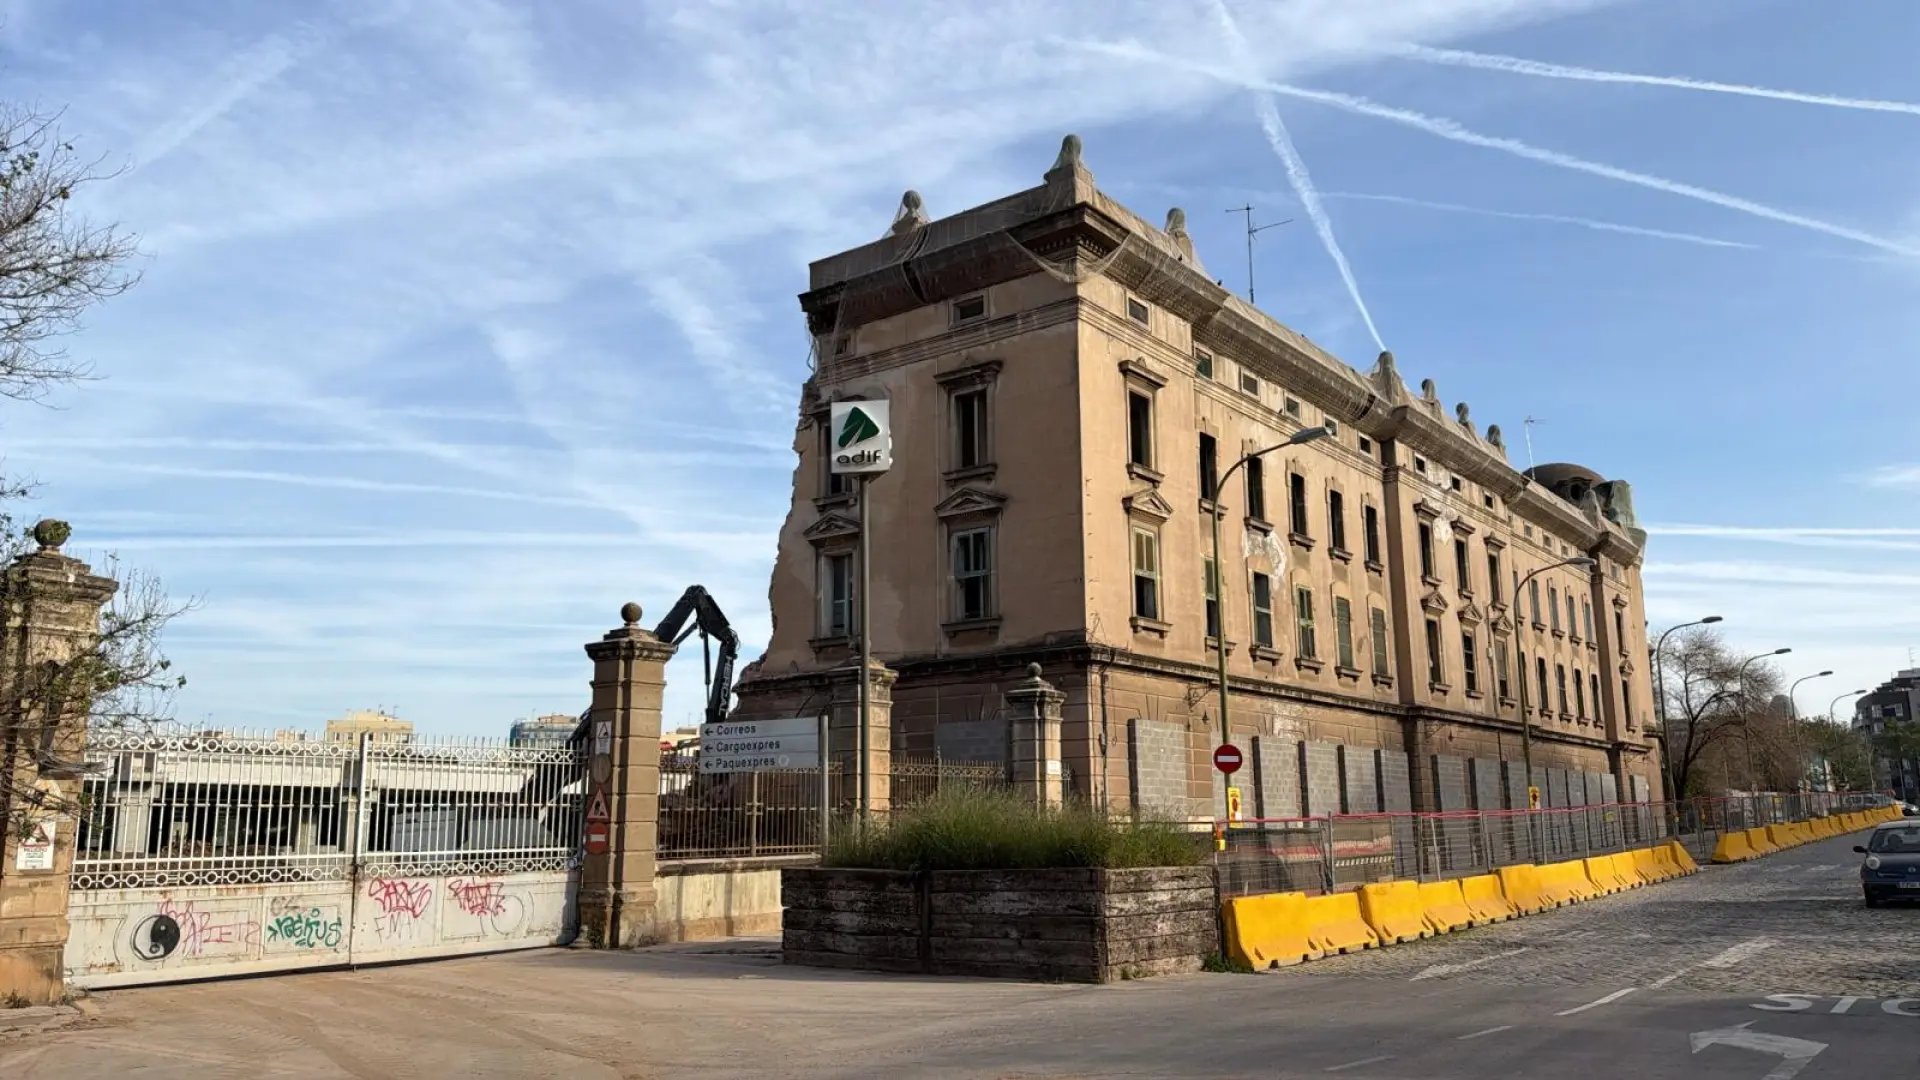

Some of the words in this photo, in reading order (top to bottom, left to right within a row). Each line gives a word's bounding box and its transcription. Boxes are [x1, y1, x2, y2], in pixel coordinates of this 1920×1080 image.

[836, 449, 883, 464] adif
[716, 725, 756, 736] Correos
[716, 740, 780, 754] Cargoexpres
[715, 757, 776, 770] Paquexpres
